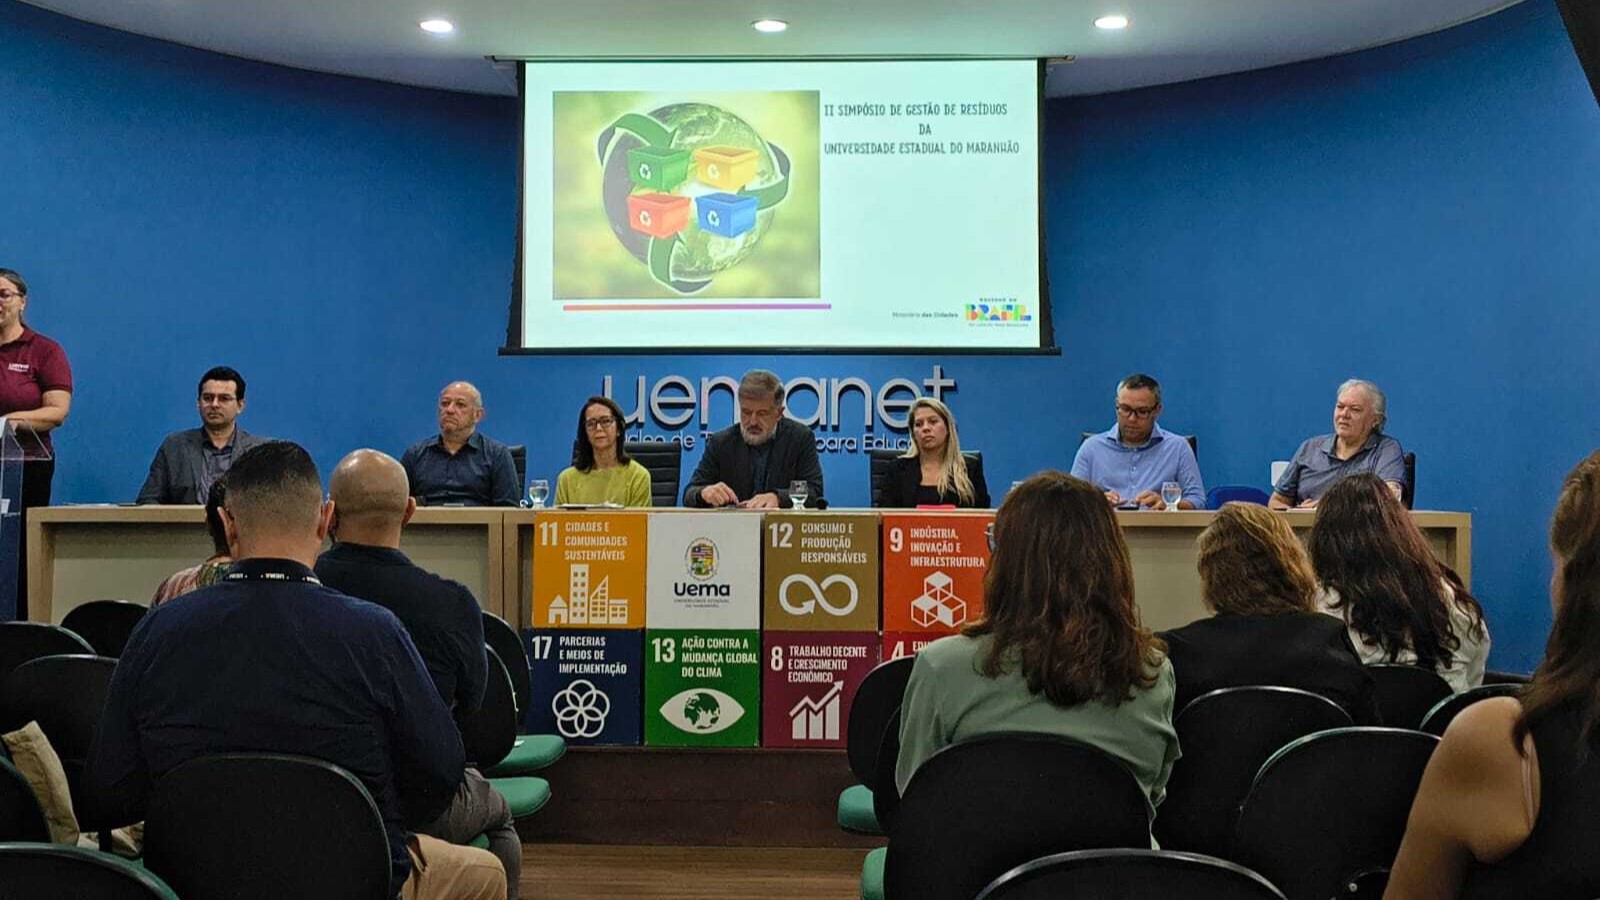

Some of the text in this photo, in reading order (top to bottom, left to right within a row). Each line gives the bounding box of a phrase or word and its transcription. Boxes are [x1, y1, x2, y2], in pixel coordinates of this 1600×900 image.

[824, 101, 1008, 116] II SIMPÓSIO DE GESTÃO DE RESÍDUOS
[918, 124, 932, 135] DA
[824, 140, 1020, 154] UNIVERSIDADE ESTADUAL DO MARANHÃO
[539, 522, 558, 546] 11
[565, 522, 609, 532] CIDADES E
[801, 523, 854, 534] CONSUMO E
[910, 525, 959, 539] INDÚSTRIA,
[565, 536, 628, 546] COMUNIDADES
[768, 523, 793, 548] 12
[890, 527, 903, 552] 9
[801, 536, 850, 551] PRODUÇÃO
[910, 540, 960, 555] INOVAÇÃO E
[564, 548, 625, 560] SUSTENTÁVEIS
[801, 550, 867, 563] RESPONSÁVEIS
[910, 556, 986, 567] INFRAESTRUTURA
[674, 582, 730, 596] Uema
[532, 636, 553, 660] 17
[560, 636, 606, 647] PARCERIAS
[682, 636, 748, 650] AÇÃO CONTRA A
[560, 650, 605, 660] E MEIOS DE
[652, 638, 675, 663] 13
[789, 646, 867, 658] TRABALHO DECENTE
[892, 641, 904, 660] 4
[682, 653, 758, 665] MUDANÇA GLOBAL
[771, 646, 783, 671] 8
[788, 659, 847, 670] E CRESCIMENTO
[559, 662, 627, 676] IMPLEMENTAÇÃO
[682, 667, 722, 677] DO CLIMA
[788, 671, 833, 683] ECONÔMICO
